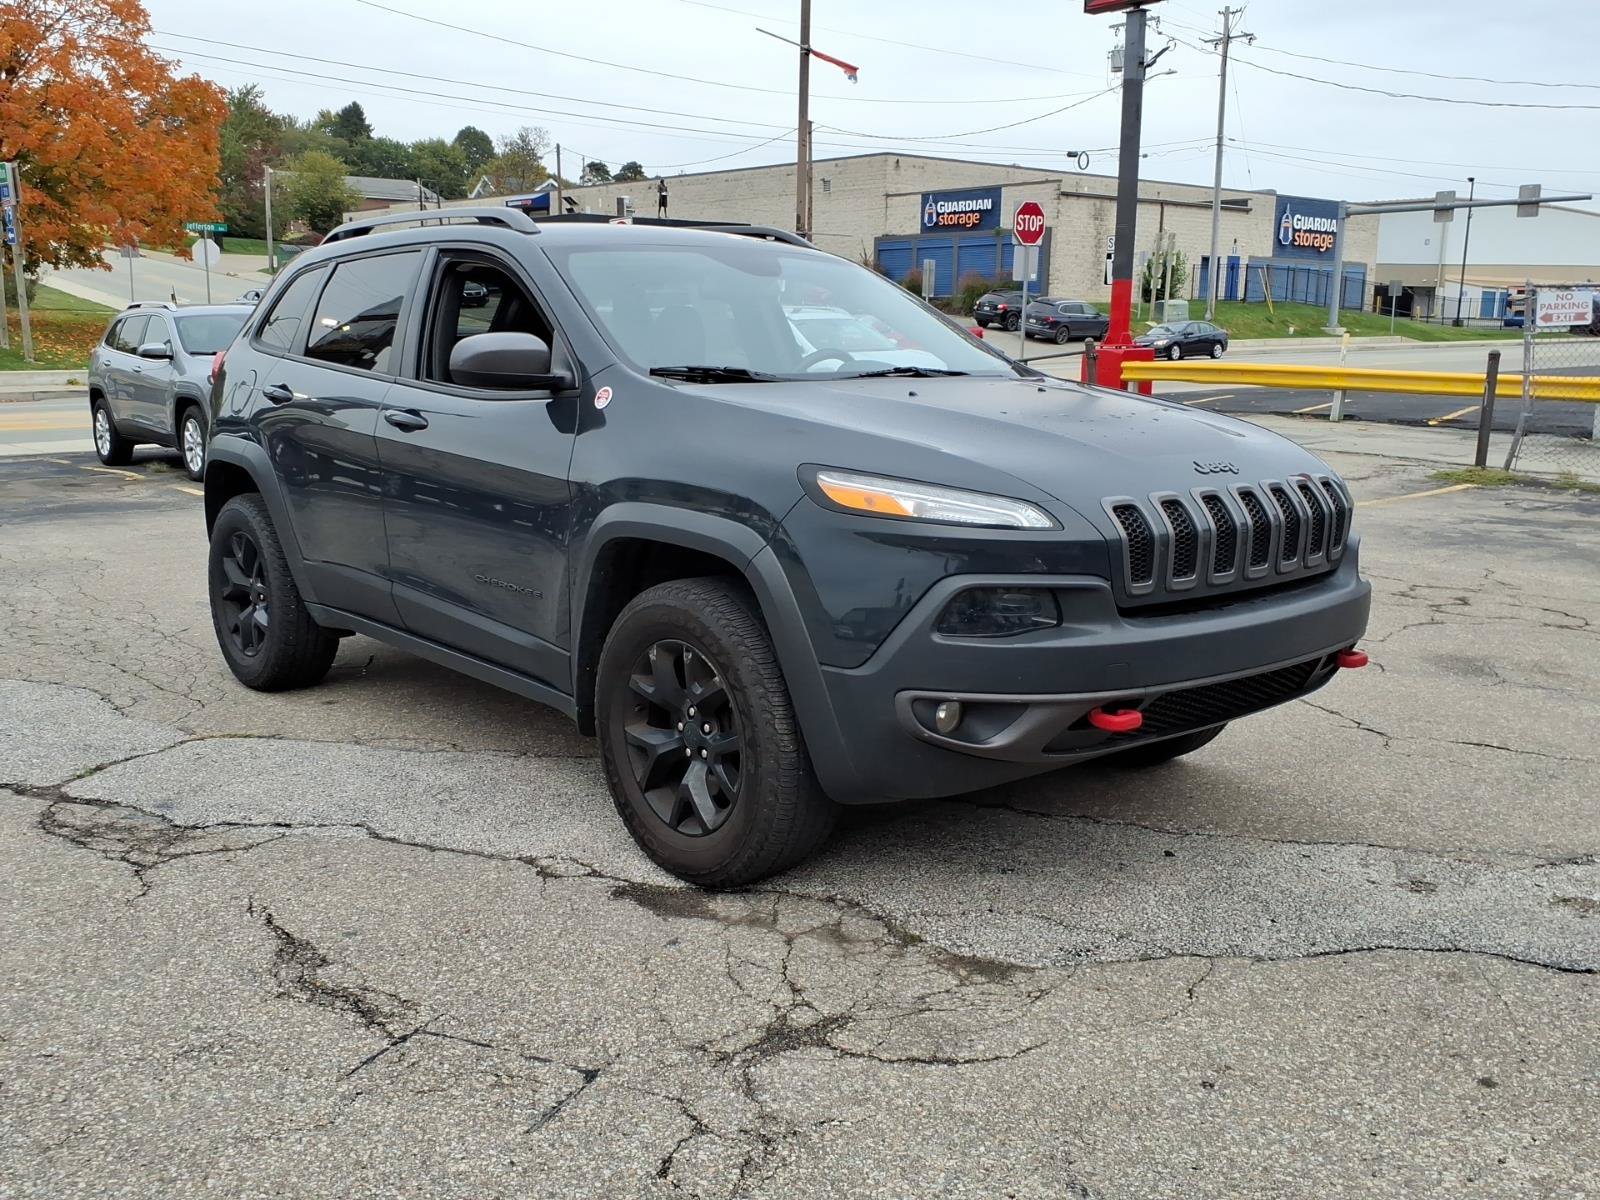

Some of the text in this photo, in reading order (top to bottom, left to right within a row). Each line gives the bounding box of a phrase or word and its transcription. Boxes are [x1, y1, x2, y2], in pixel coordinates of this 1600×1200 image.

[937, 199, 992, 214] GUARDIAN
[938, 212, 980, 227] storage
[1017, 215, 1043, 232] STOP
[1293, 214, 1337, 232] GUARDIA
[186, 223, 215, 231] Jefferson
[1294, 229, 1334, 252] storage
[1556, 293, 1574, 301] NO
[1540, 301, 1589, 311] PARKING
[1553, 313, 1574, 322] EXIT
[1193, 461, 1240, 475] Jeep
